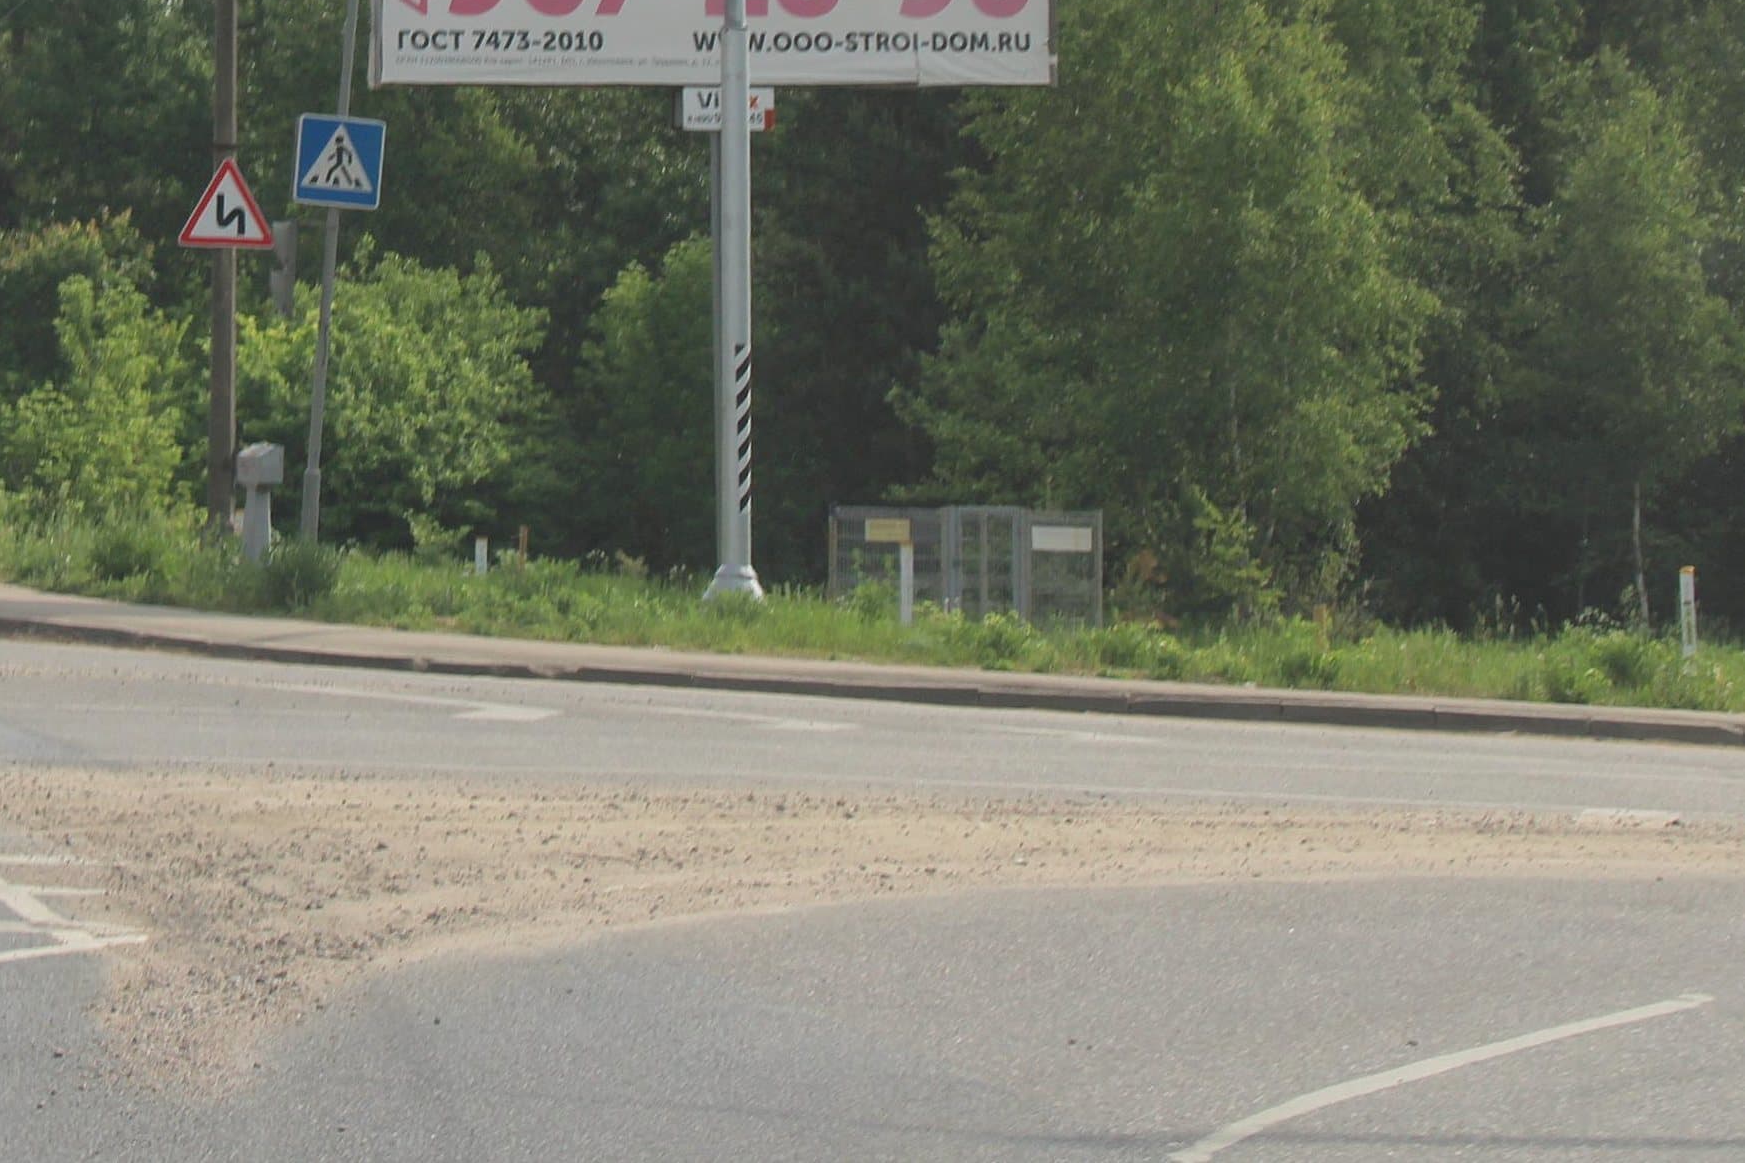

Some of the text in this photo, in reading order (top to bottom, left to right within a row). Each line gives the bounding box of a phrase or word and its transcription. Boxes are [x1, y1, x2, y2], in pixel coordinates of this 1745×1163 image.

[397, 30, 604, 52] ГОСТ 7473-2010
[692, 29, 1032, 54] WW.OOO-STROI-DOM.RU
